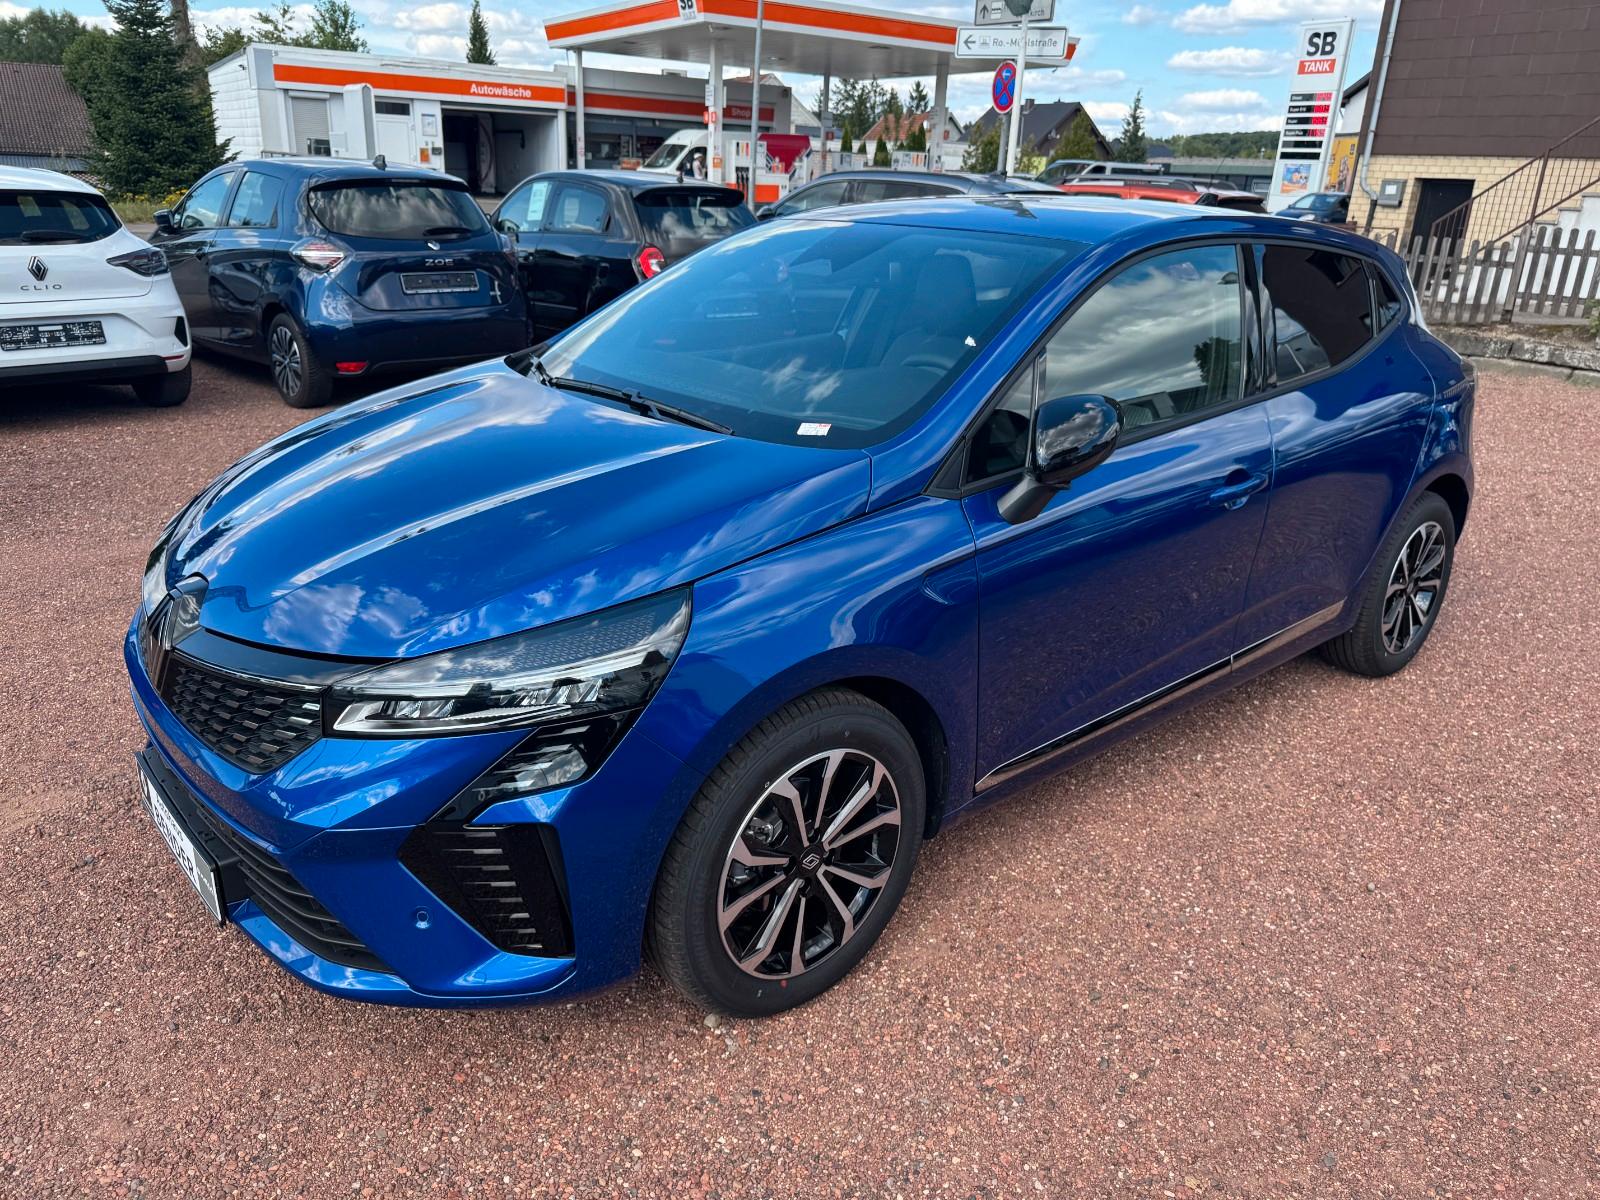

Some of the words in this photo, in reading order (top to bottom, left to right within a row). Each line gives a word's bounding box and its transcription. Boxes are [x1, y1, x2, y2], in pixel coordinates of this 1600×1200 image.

[1306, 31, 1337, 57] SB
[1303, 60, 1332, 73] TANK
[470, 83, 532, 98] Autowäsche
[424, 258, 454, 266] ZOE
